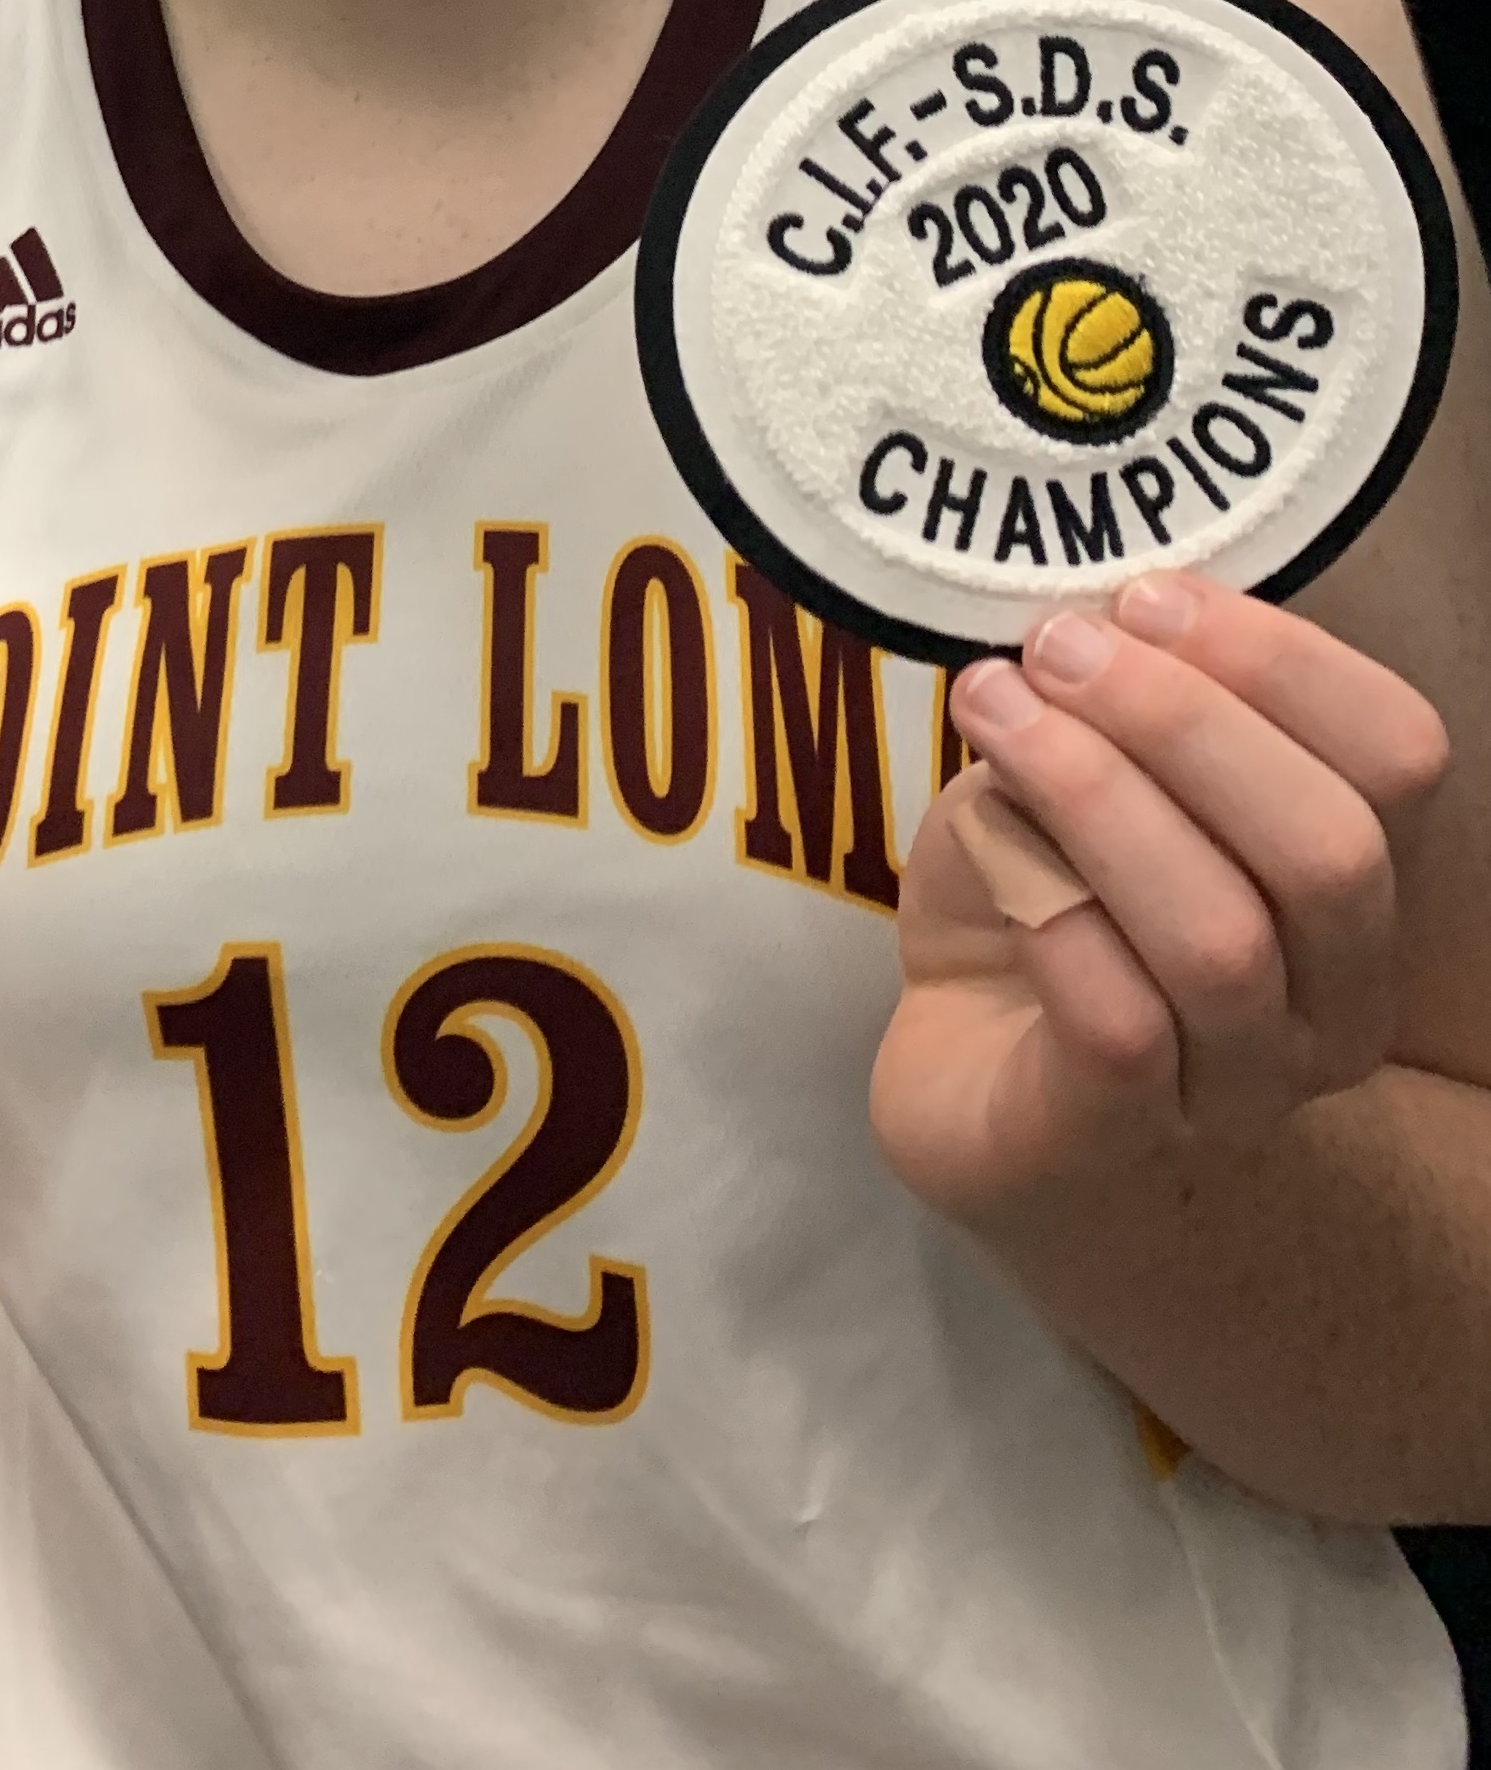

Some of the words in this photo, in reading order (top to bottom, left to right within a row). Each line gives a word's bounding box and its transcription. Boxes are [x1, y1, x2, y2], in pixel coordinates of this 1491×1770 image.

[909, 147, 1107, 287] 2020
[857, 291, 1335, 566] CHAMPIONS
[467, 521, 972, 920] LOM
[142, 942, 652, 1438] 12
